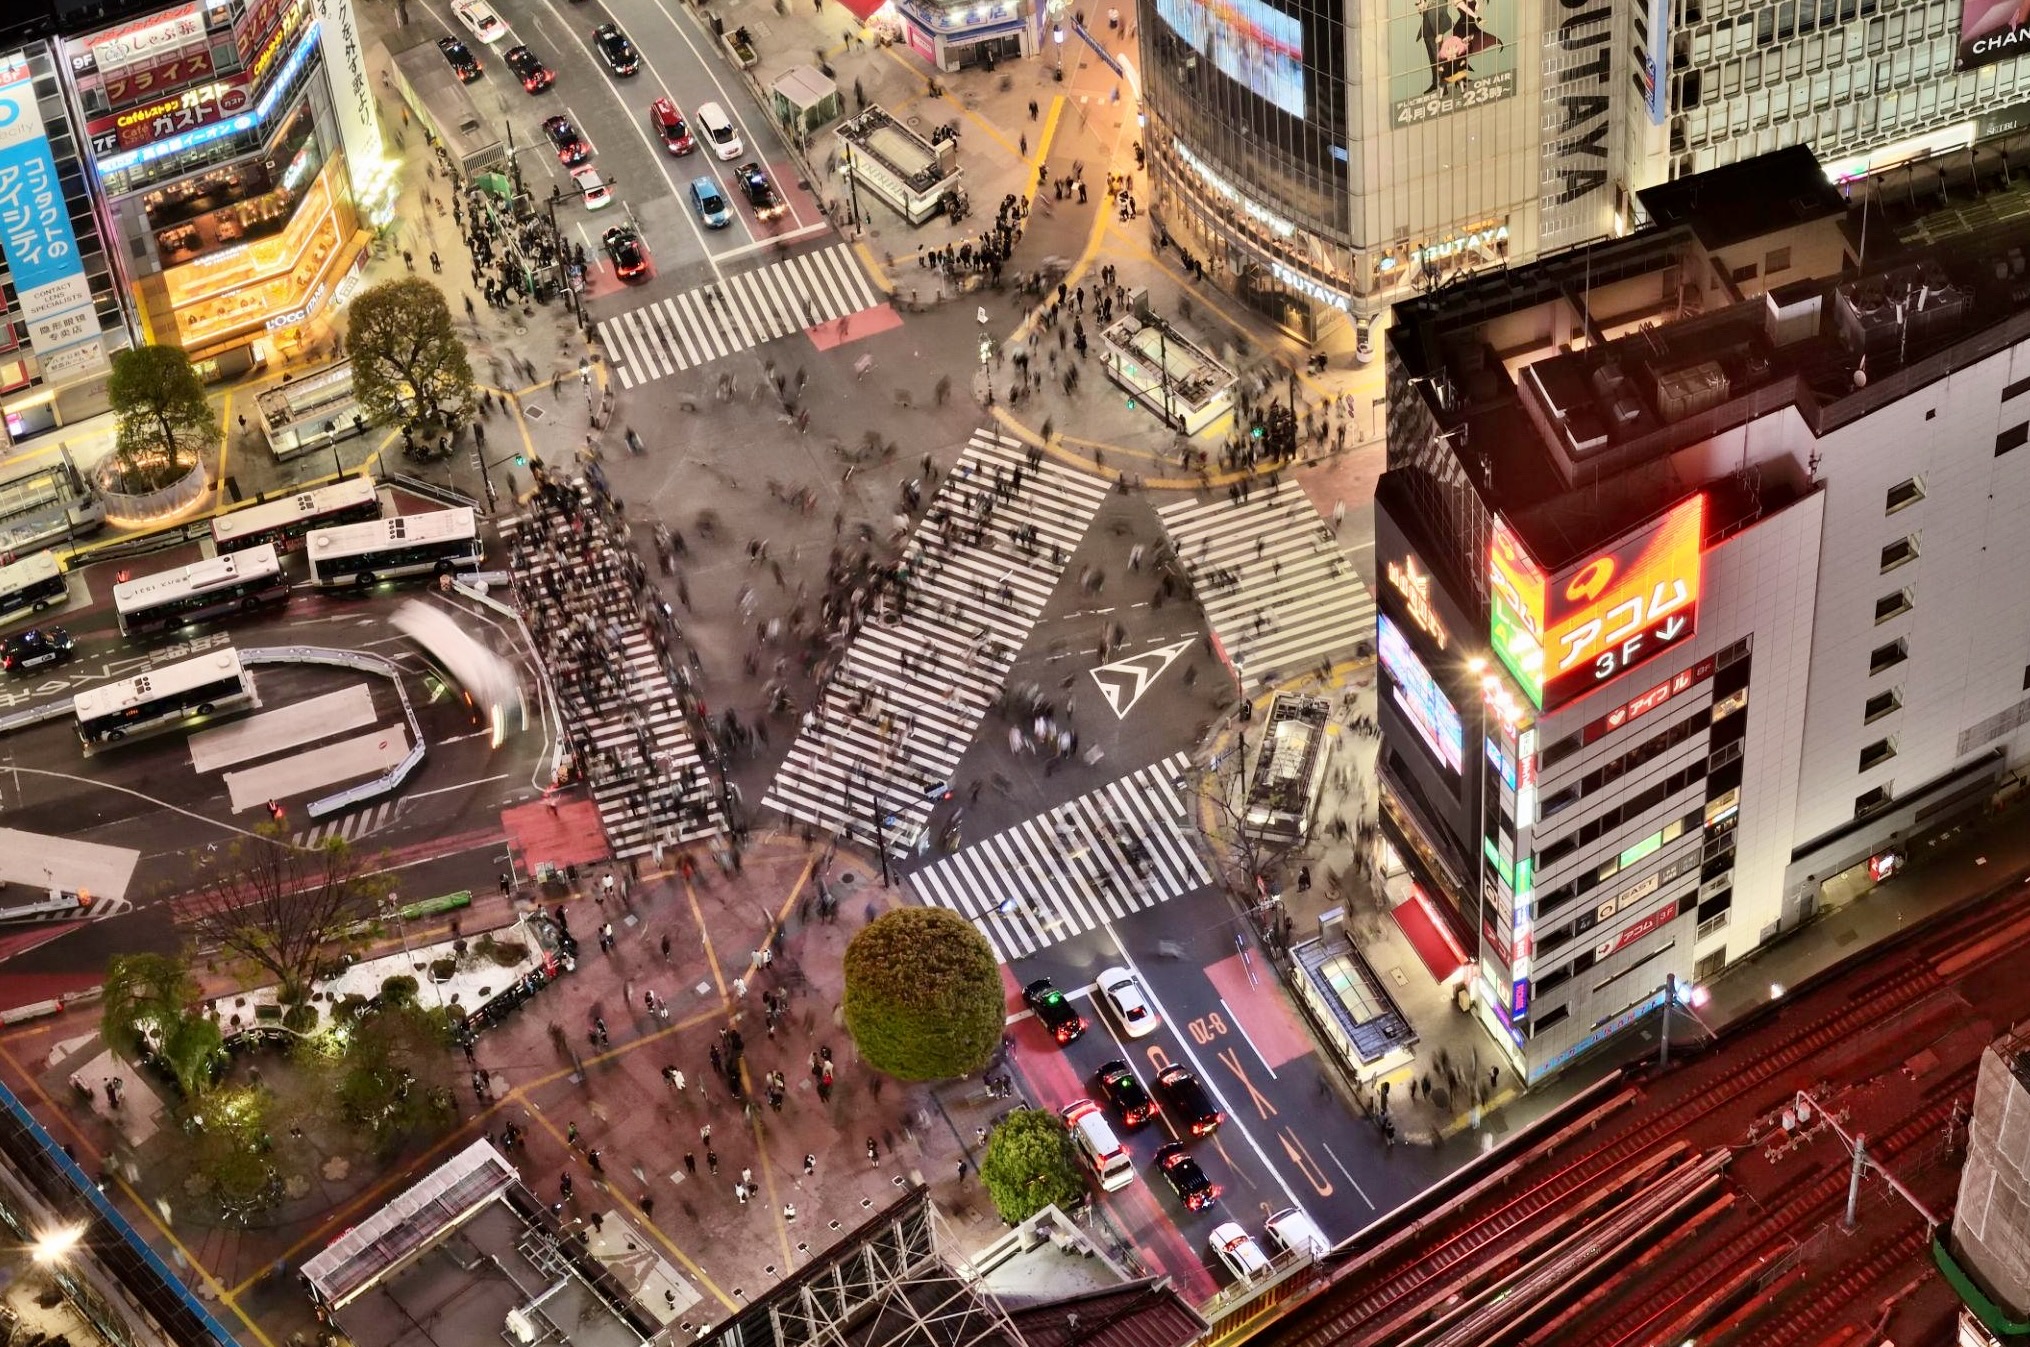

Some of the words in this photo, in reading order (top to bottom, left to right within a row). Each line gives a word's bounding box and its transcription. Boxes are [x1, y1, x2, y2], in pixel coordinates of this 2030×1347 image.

[72, 56, 93, 70] 9F
[1474, 78, 1491, 89] ON
[1493, 72, 1511, 84] AIR
[1557, 0, 1611, 205] UTAYA
[153, 106, 213, 137] ガスト
[93, 135, 117, 151] 7F
[0, 164, 42, 265] アイシティ
[25, 157, 69, 258] コンタクトの
[1410, 226, 1509, 263] TSUTAYA
[30, 292, 83, 315] SPECIALISTS
[33, 282, 72, 299] CONTACT
[44, 291, 66, 303] LENS
[1271, 262, 1348, 312] TSUTAYA
[1490, 560, 1537, 634] アコム
[1559, 578, 1688, 670] アコム
[1594, 633, 1643, 679] 3F
[1630, 673, 1690, 716] アイフル
[1623, 920, 1654, 943] アコム
[1660, 906, 1675, 920] 3F
[1188, 1012, 1228, 1045] 8-20
